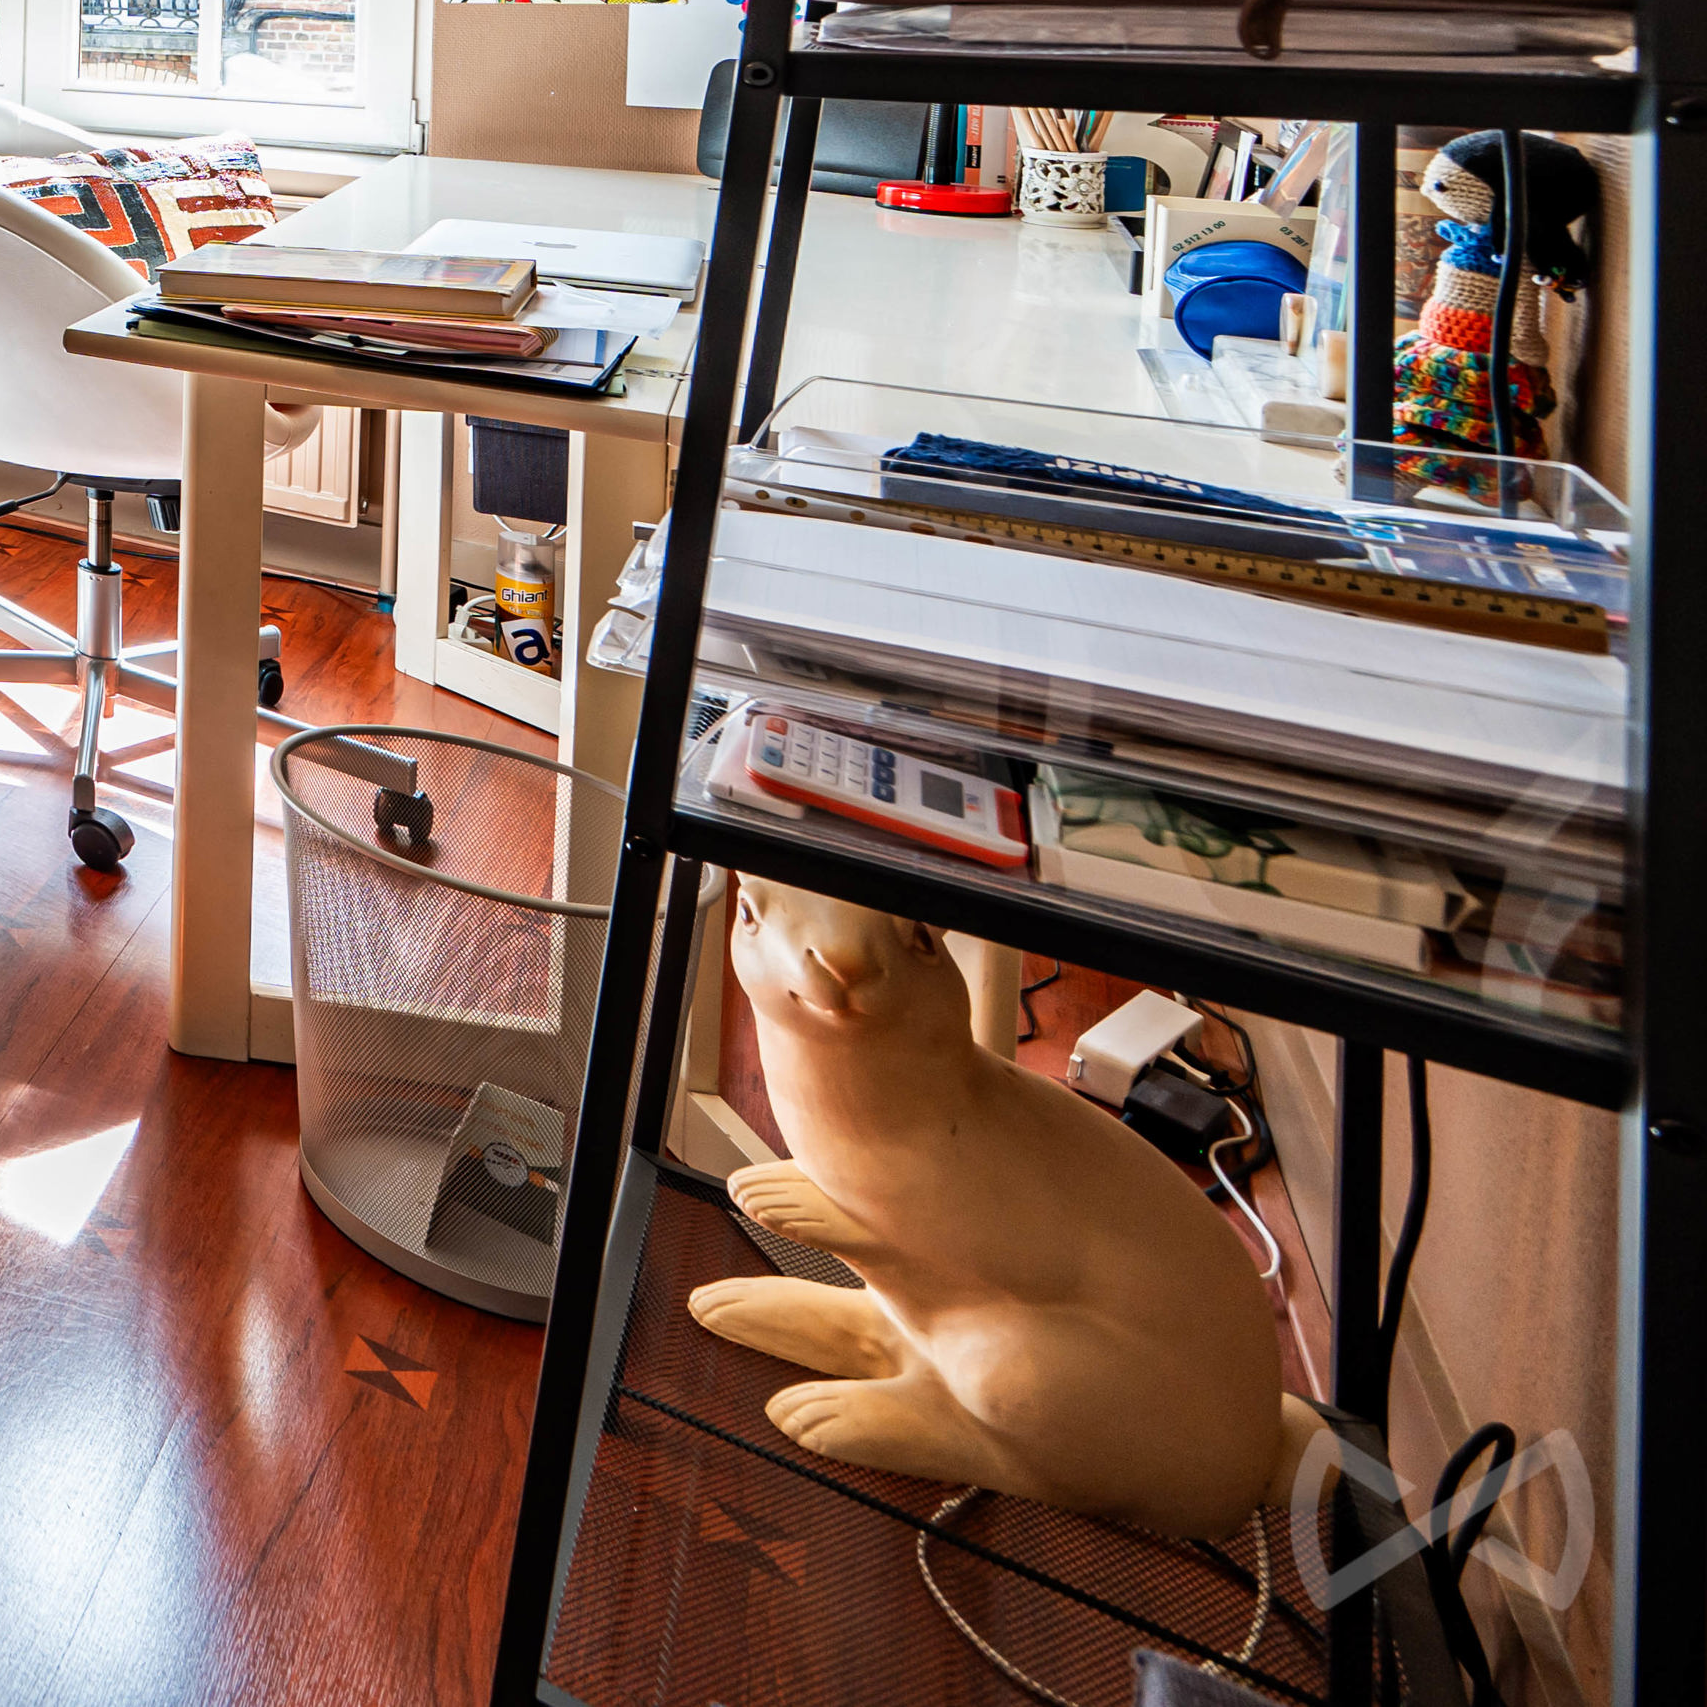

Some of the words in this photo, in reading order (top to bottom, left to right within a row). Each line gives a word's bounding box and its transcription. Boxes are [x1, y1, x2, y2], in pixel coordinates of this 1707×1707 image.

[1171, 243, 1184, 253] 02
[1183, 233, 1201, 246] 512
[1201, 227, 1214, 236] 13
[1212, 220, 1226, 229] 00
[1279, 226, 1293, 237] 03
[501, 588, 549, 603] Ghiant
[511, 627, 551, 666] a
